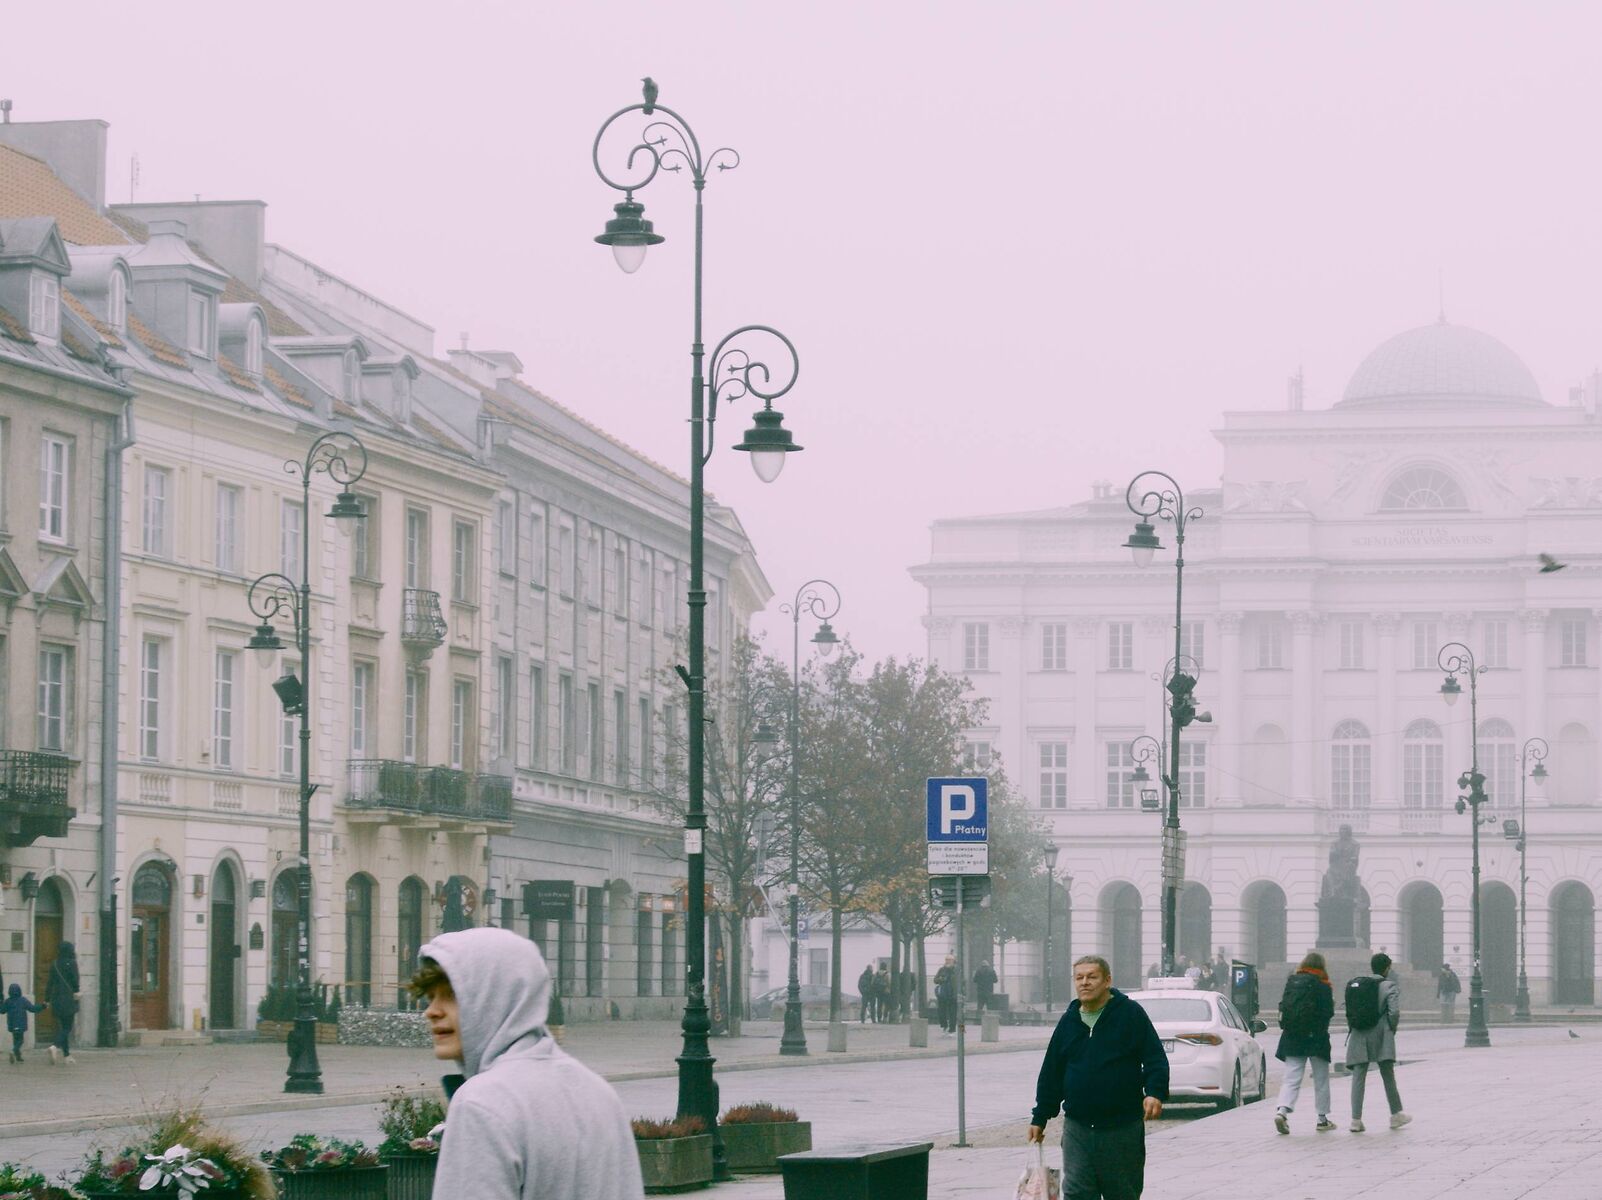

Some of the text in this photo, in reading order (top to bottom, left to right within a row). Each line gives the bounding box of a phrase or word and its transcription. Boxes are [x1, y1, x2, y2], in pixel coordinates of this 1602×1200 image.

[941, 785, 975, 834] P
[955, 825, 986, 836] Płatny
[1236, 971, 1244, 983] P
